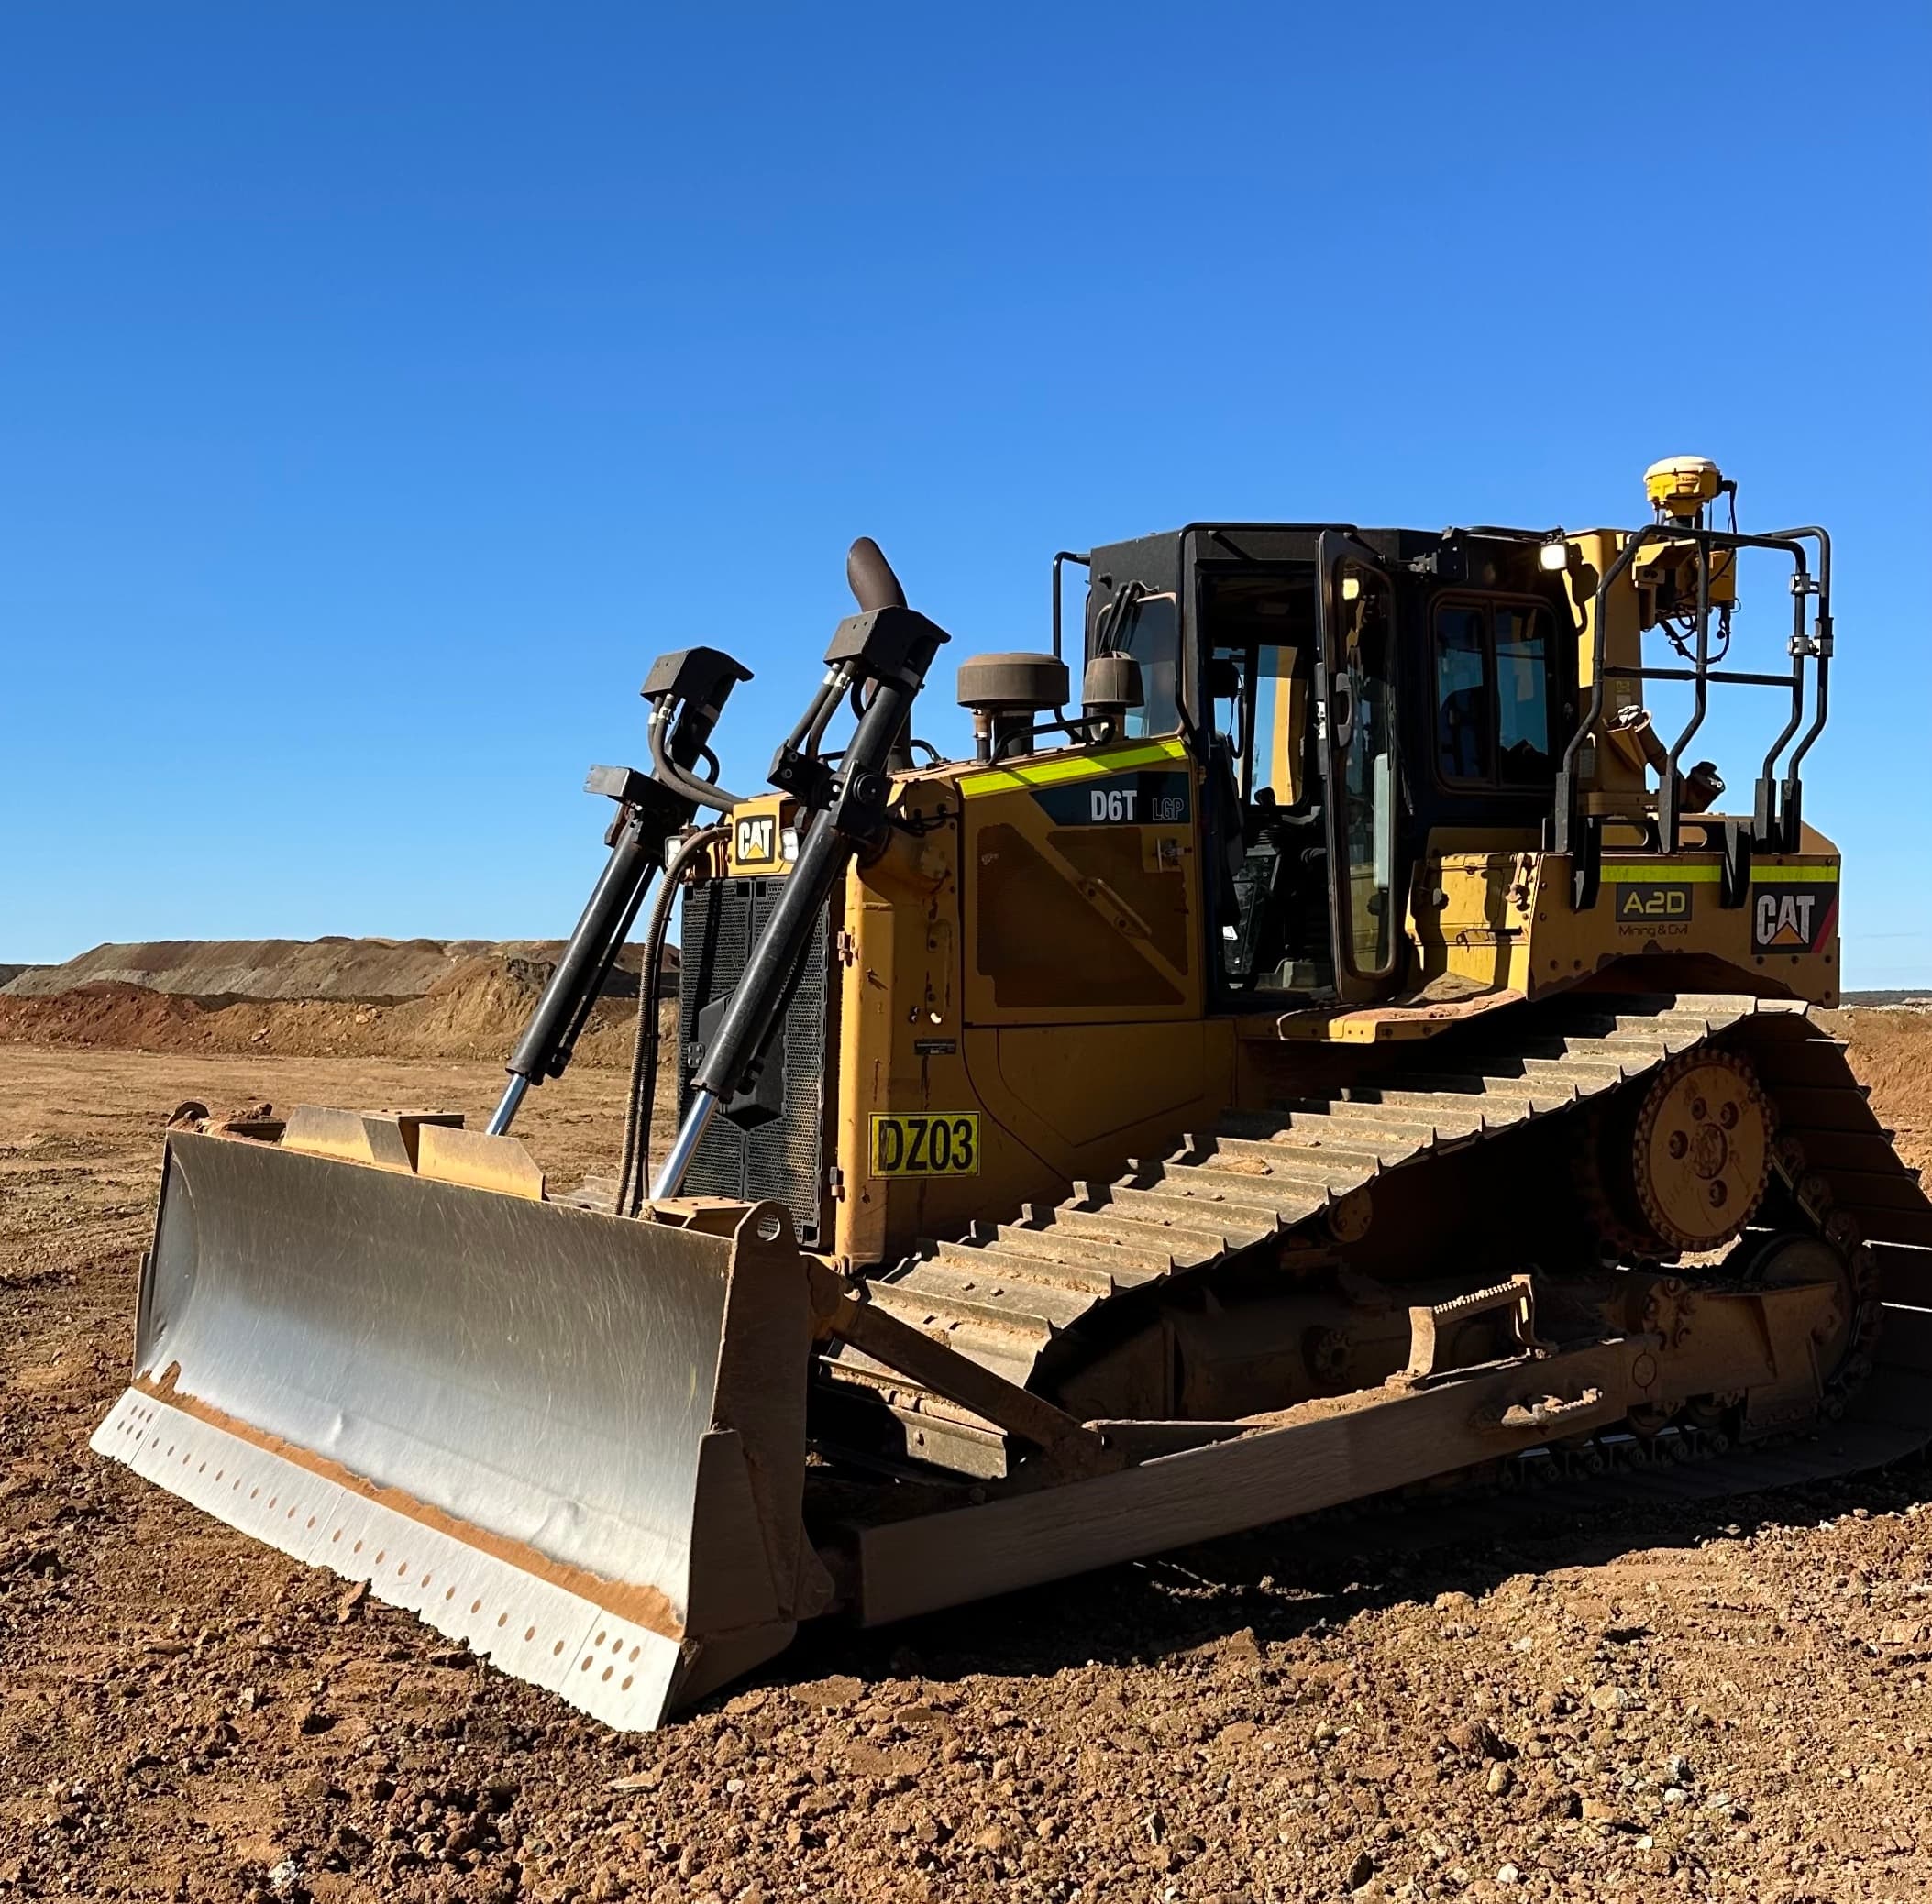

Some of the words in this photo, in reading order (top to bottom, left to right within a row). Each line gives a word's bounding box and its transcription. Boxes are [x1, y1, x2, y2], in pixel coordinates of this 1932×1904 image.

[1091, 790, 1137, 821] D6T
[1152, 798, 1184, 820] LGP
[738, 820, 772, 860] CAT
[1623, 891, 1685, 914] A2D
[1757, 895, 1815, 945] CAT
[1658, 924, 1666, 935] &
[878, 1119, 972, 1171] DZ03
